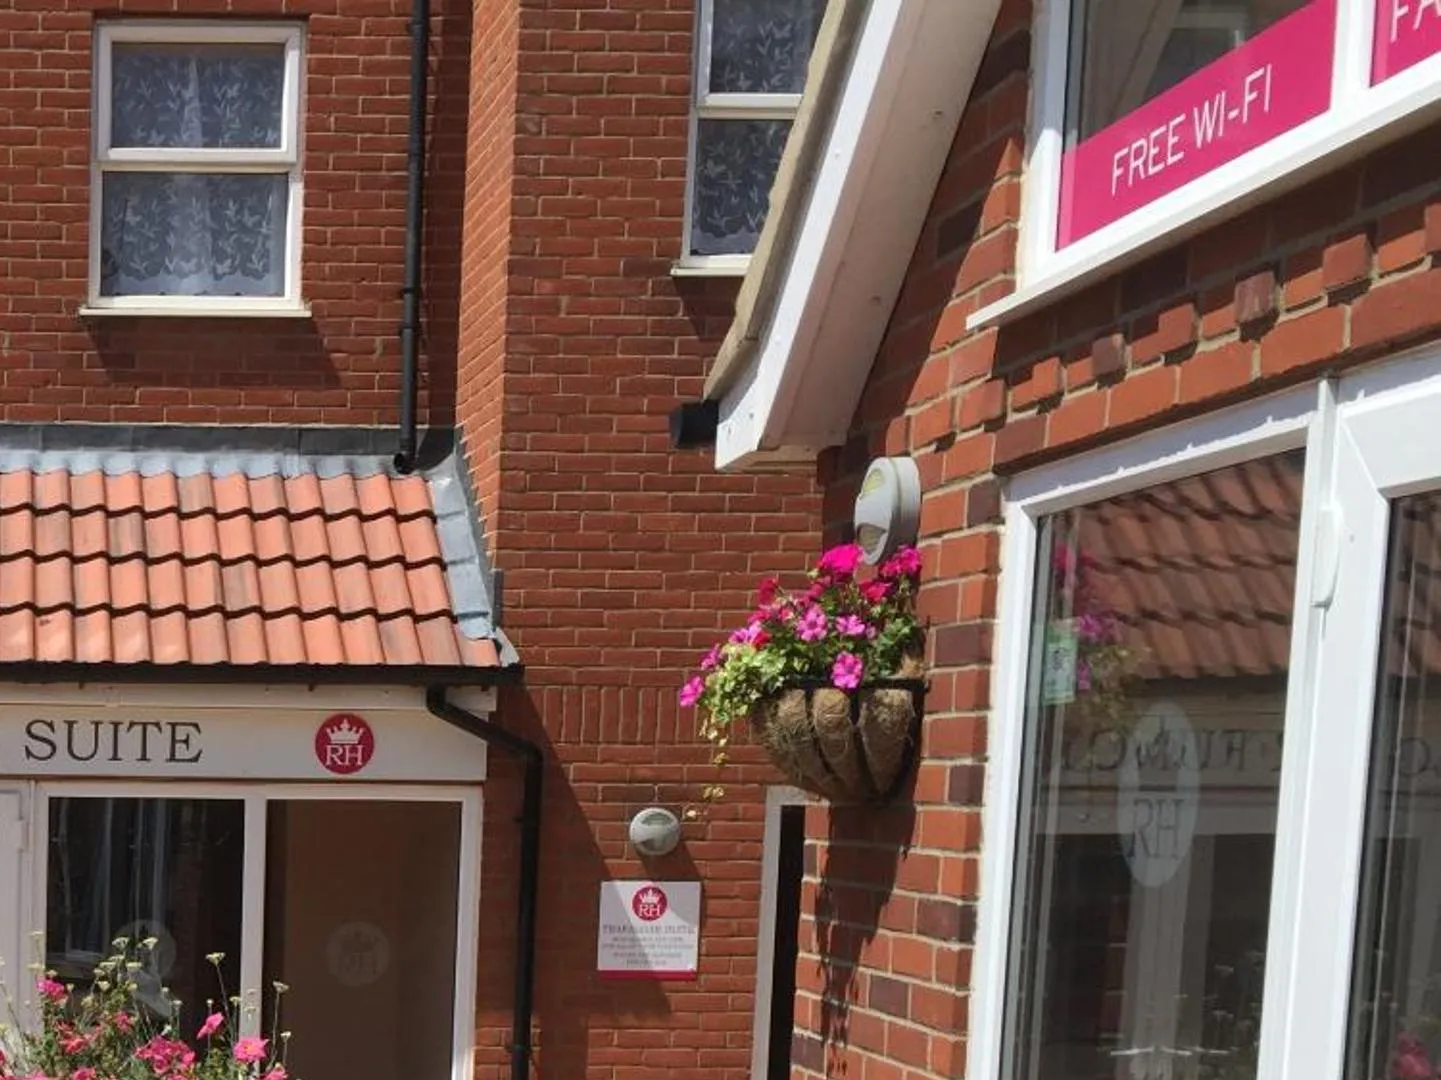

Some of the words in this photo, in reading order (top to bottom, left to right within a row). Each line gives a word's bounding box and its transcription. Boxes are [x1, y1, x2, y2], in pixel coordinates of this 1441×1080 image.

[1111, 112, 1187, 196] FREE
[1192, 64, 1272, 149] WI-FI
[24, 719, 204, 764] SUITE
[326, 744, 363, 765] RH
[639, 903, 661, 917] RH
